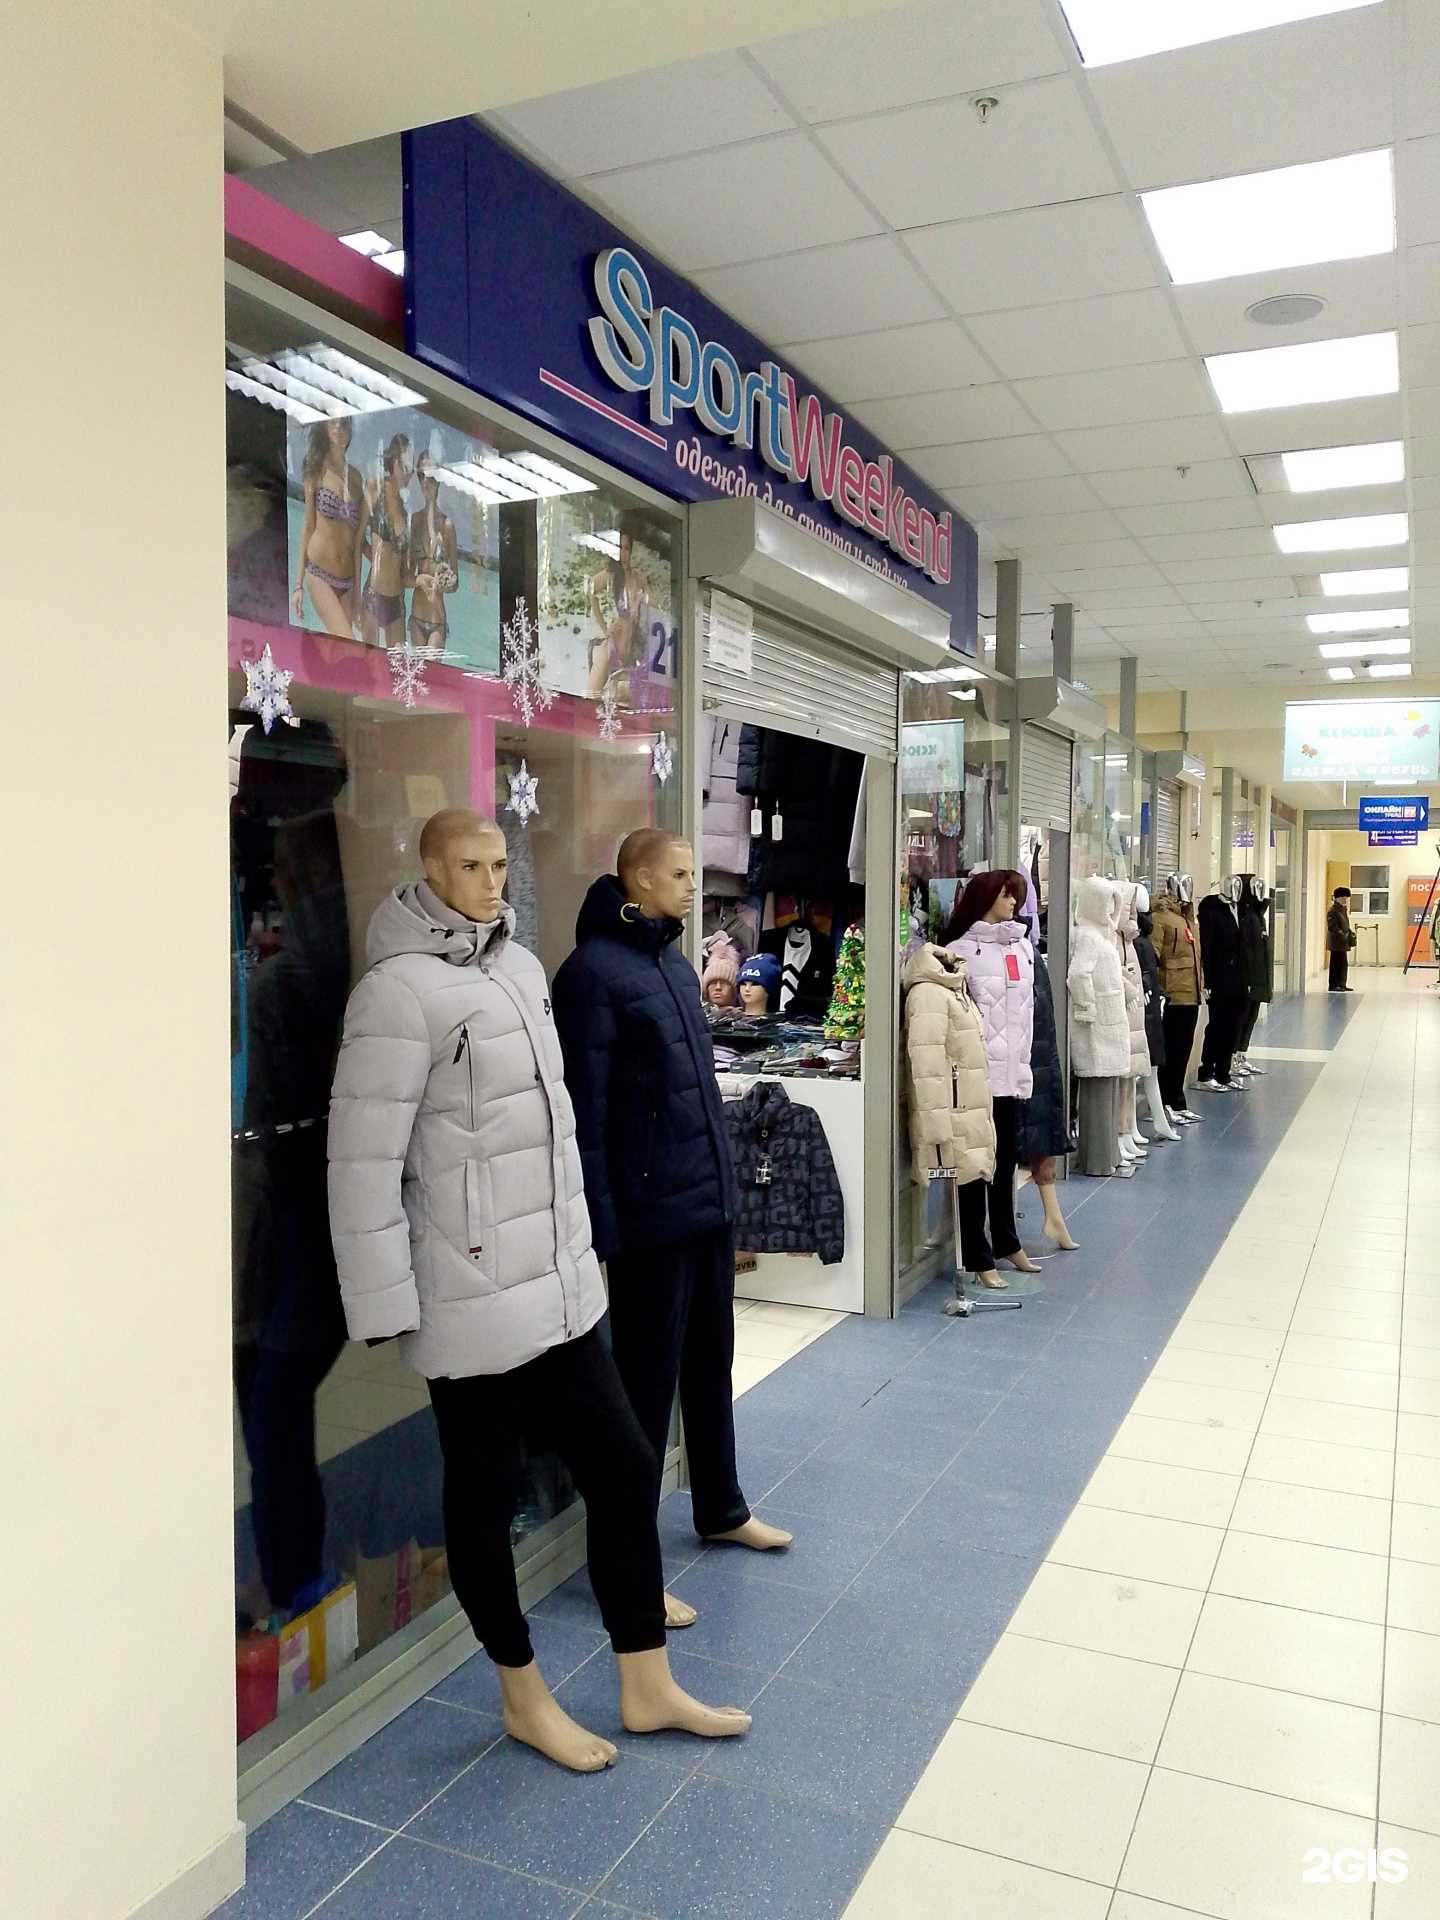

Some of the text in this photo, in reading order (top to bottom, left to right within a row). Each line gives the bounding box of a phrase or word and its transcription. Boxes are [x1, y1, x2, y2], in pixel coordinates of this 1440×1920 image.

[588, 247, 952, 585] SportWeekend
[676, 437, 759, 497] одежда
[1290, 764, 1359, 777] ОДЕЖДА
[1364, 804, 1402, 814] ОНЛАЙН
[741, 968, 761, 977] FILA
